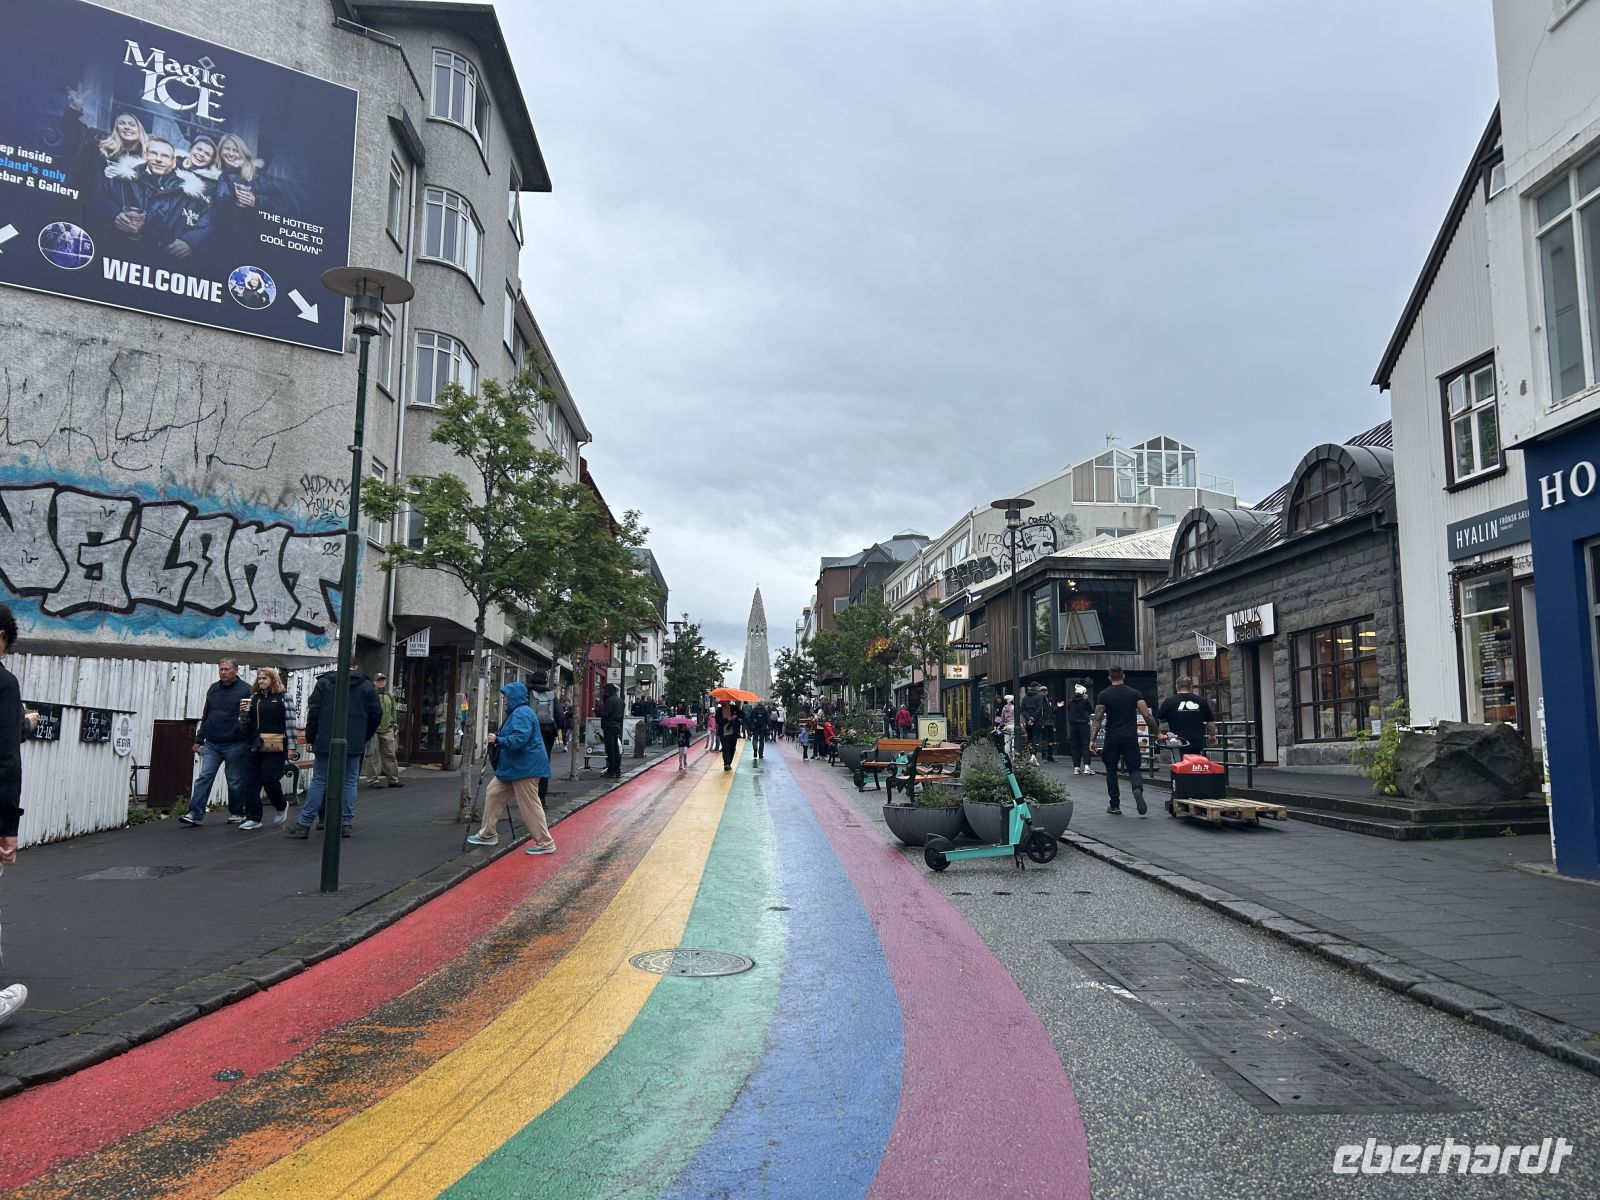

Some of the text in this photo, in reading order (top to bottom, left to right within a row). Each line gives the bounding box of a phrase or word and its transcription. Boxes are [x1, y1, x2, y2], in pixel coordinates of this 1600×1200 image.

[122, 39, 226, 89] Magic
[140, 68, 226, 122] ICE
[17, 146, 53, 164] inside
[41, 168, 66, 182] only
[26, 176, 35, 187] &
[38, 178, 79, 200] Gallery
[258, 210, 325, 234] "THE HOTTEST
[260, 234, 323, 255] COOL DOWN"
[279, 227, 324, 245] PLACE TO
[102, 256, 223, 304] WELCOME
[1538, 460, 1597, 511] HO
[1455, 519, 1498, 549] HYALIN
[35, 725, 53, 739] 12-18
